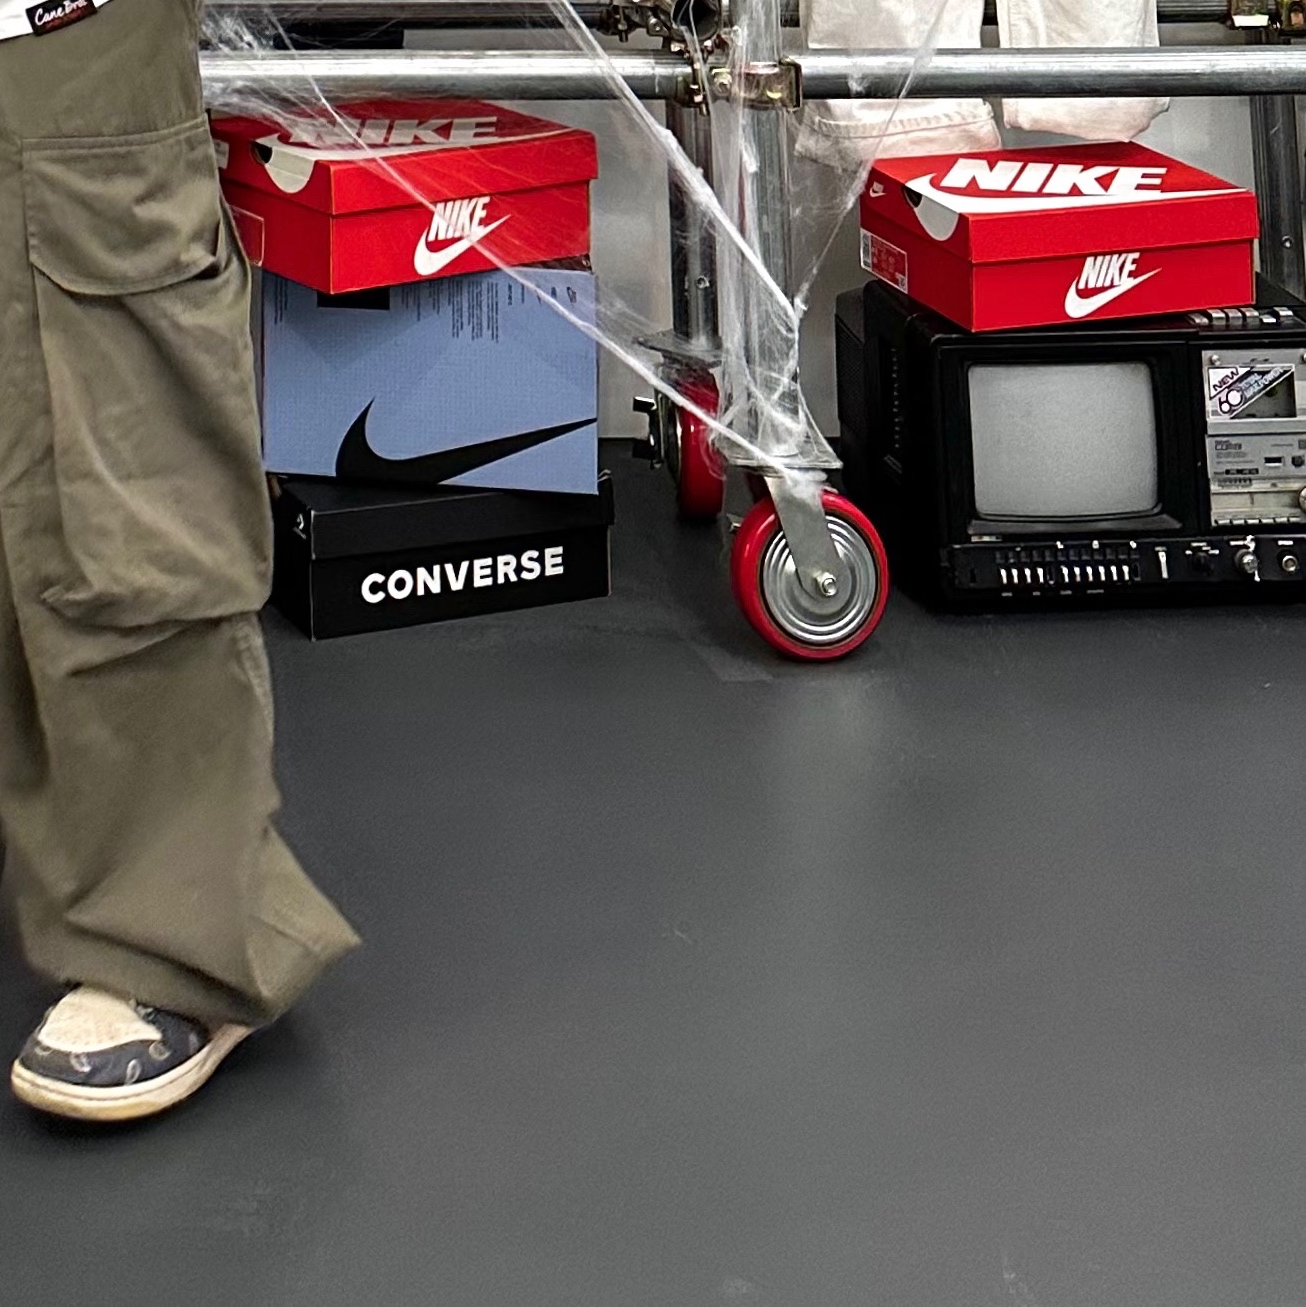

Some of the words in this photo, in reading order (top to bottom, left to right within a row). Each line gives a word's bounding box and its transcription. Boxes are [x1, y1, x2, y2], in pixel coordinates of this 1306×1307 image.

[34, 6, 65, 26] Cane
[296, 116, 498, 147] NIKE
[939, 158, 1168, 196] NIKE
[426, 195, 492, 243] NIKE
[1077, 251, 1141, 289] NIKE
[1212, 367, 1240, 392] NEW
[1218, 388, 1243, 414] 60
[360, 545, 565, 605] CONVERSE
